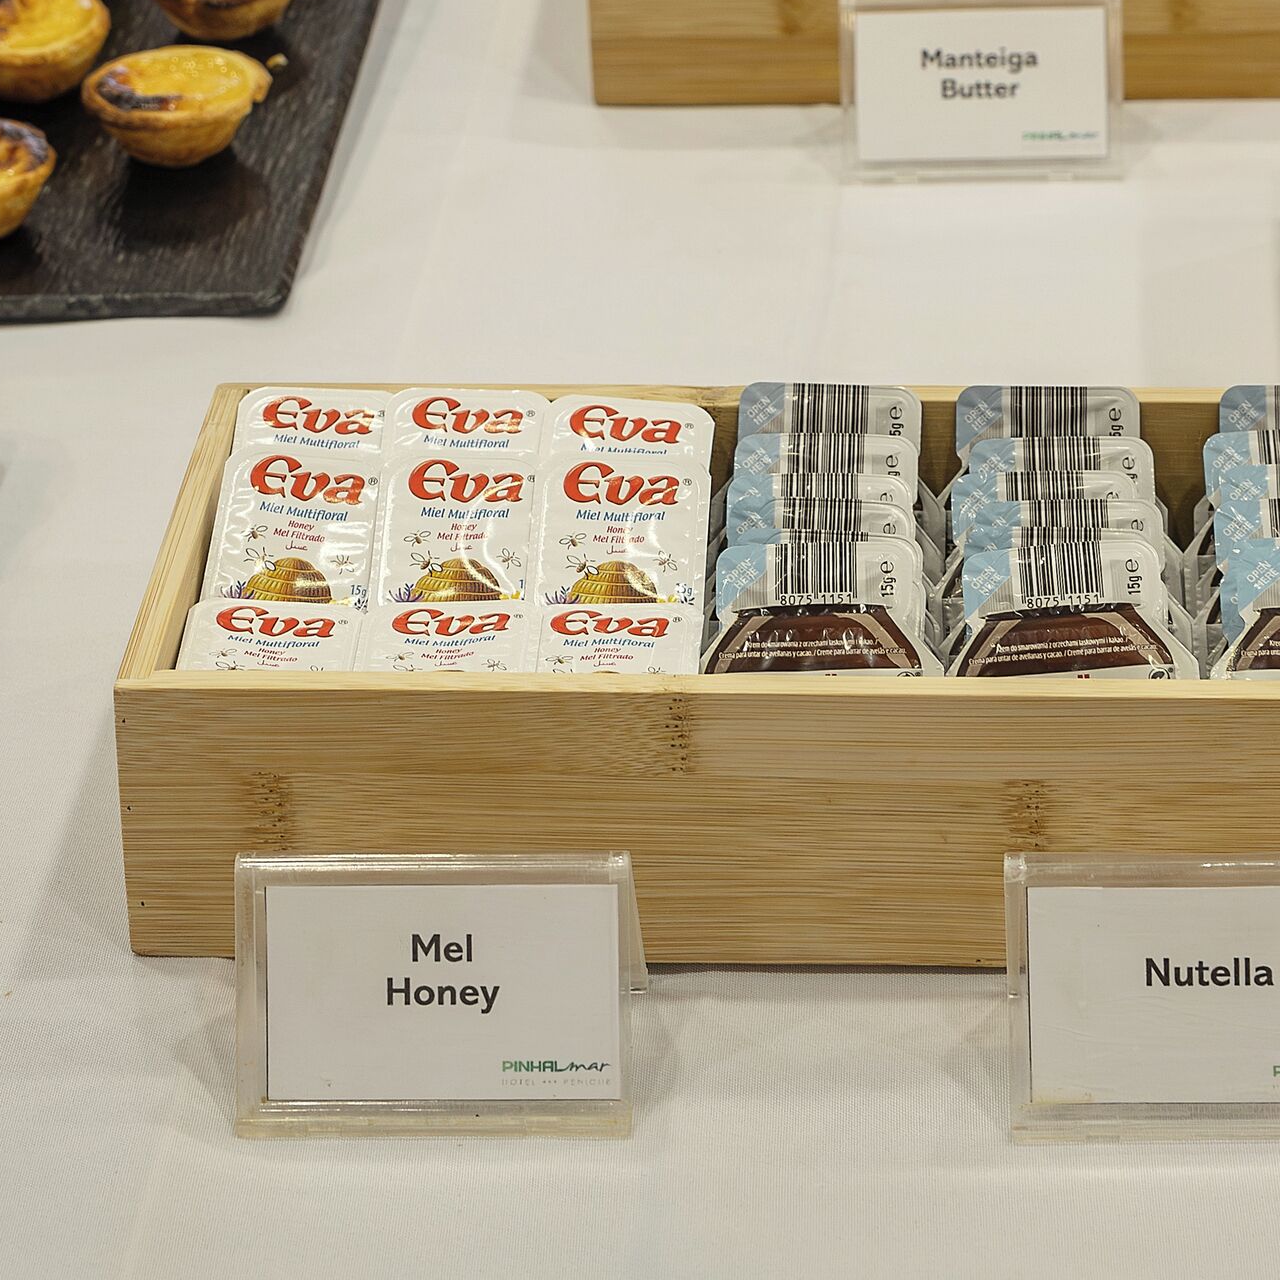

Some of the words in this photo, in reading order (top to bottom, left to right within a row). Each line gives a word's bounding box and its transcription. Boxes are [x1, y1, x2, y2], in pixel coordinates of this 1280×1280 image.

[921, 48, 1038, 73] Manteiga
[941, 78, 1019, 99] Butter
[263, 394, 375, 435] Eva
[412, 396, 524, 434] Eva
[746, 395, 772, 418] OPEN
[753, 405, 778, 425] HERE
[964, 400, 989, 424] OPEN
[1227, 399, 1252, 424] OPEN
[569, 404, 682, 444] Eva
[971, 409, 995, 431] HERE
[1234, 408, 1260, 431] HERE
[273, 434, 297, 444] Miel
[299, 437, 360, 450] Multifloral
[423, 434, 447, 446] Miel
[449, 437, 510, 449] Multifloral
[742, 446, 766, 469] OPEN
[1212, 445, 1237, 469] OPEN
[250, 454, 366, 506] Eva
[407, 459, 525, 504] Eva
[563, 461, 680, 506] Eva
[1229, 477, 1255, 501] OPEN
[259, 501, 284, 515] Miel
[286, 506, 349, 521] Multifloral
[420, 506, 445, 519] Miel
[576, 509, 601, 521] Miel
[273, 527, 290, 537] Mel
[291, 530, 325, 543] Filtrado
[287, 520, 315, 532] Honey
[436, 532, 453, 541] Mel
[1230, 520, 1255, 543] HERE
[592, 535, 609, 544] Mel
[970, 565, 996, 590] OPEN
[1246, 559, 1272, 584] OPEN
[1254, 567, 1280, 590] HERE
[350, 584, 367, 598] 15g
[880, 577, 897, 598] 15g
[1127, 575, 1142, 595] 15g
[780, 594, 812, 606] 8075
[821, 593, 852, 605] 1151
[1026, 595, 1060, 609] 8075
[1067, 593, 1100, 606] 1151
[215, 605, 336, 638] Eva
[392, 608, 511, 637] Eva
[550, 610, 669, 638] Eva
[227, 634, 253, 645] Miel
[255, 639, 320, 649] Multifloral
[404, 637, 430, 646] Miel
[432, 634, 496, 648] Multifloral
[435, 647, 462, 655] Honey
[563, 638, 588, 648] Miel
[591, 638, 655, 649] Multifloral
[593, 647, 622, 655] Honey
[243, 650, 262, 658] Mel
[262, 654, 299, 663] Filtrado
[257, 648, 286, 656] Honey
[438, 651, 475, 660] Filtrado
[598, 653, 634, 661] Filtrado
[411, 933, 473, 962] Mel
[1145, 957, 1275, 987] Nutella
[386, 977, 500, 1013] Honey
